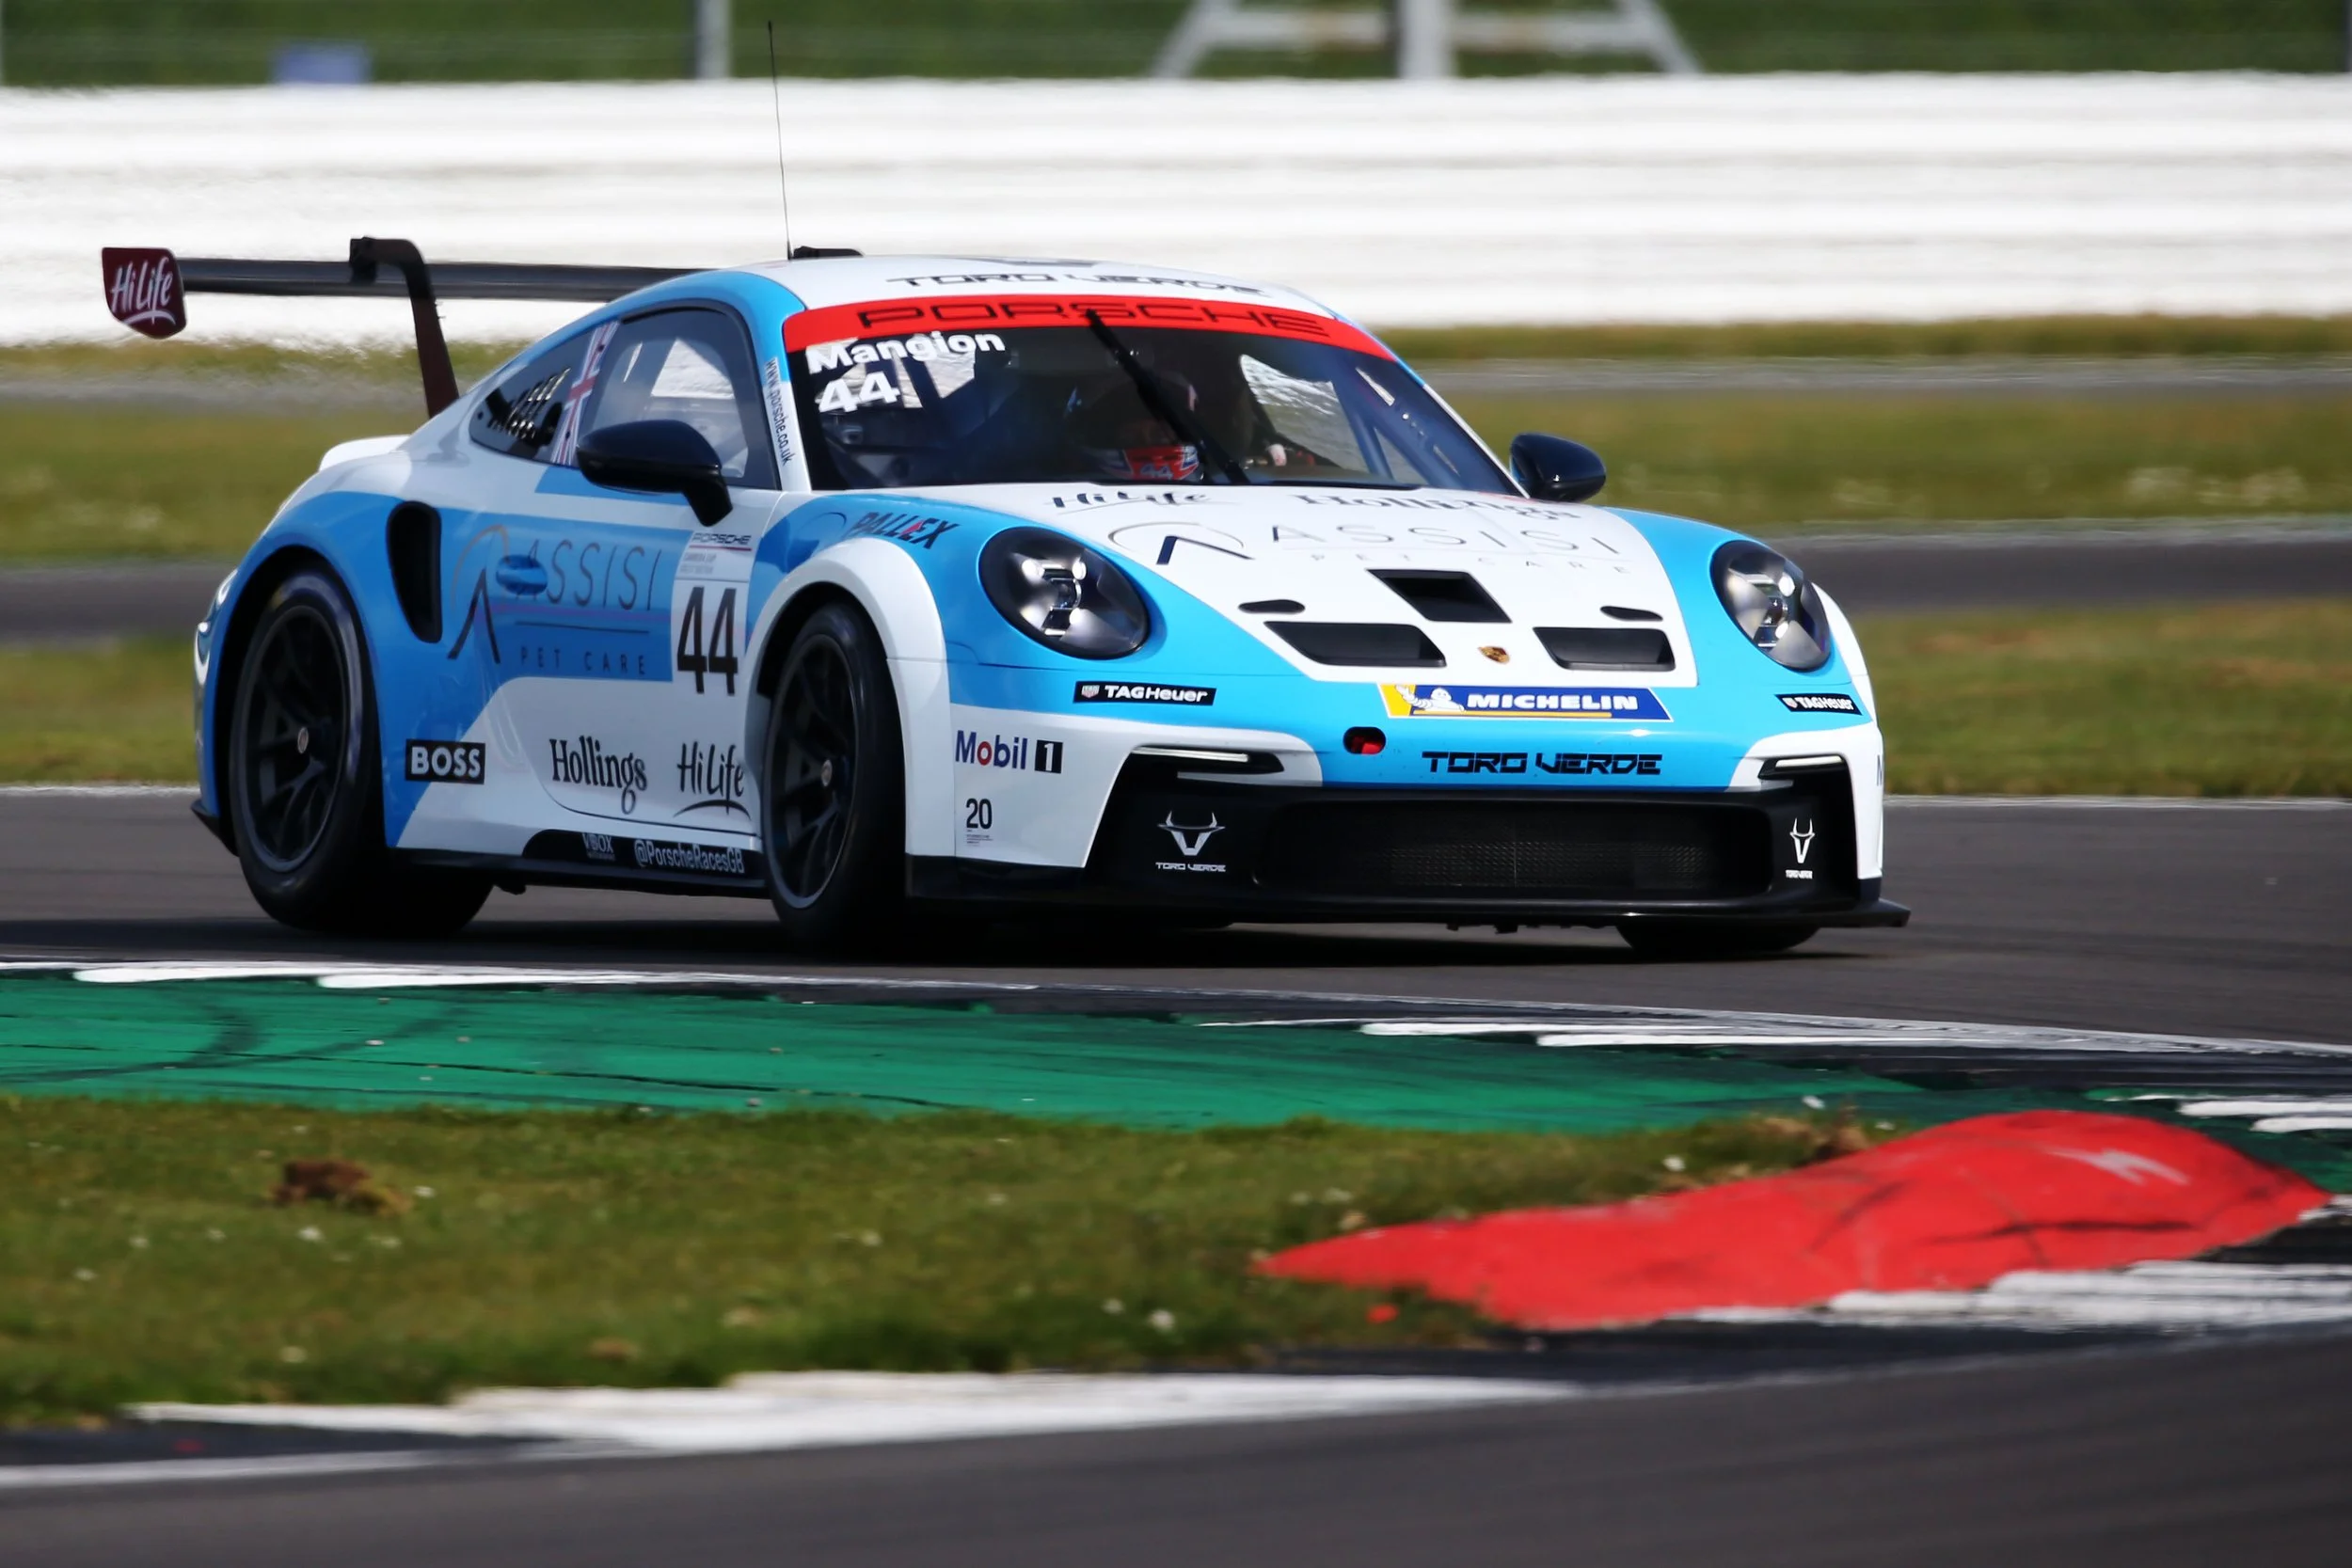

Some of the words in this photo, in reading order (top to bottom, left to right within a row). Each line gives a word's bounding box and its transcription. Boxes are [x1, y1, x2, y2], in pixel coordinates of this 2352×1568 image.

[110, 255, 174, 325] HiLife
[857, 300, 1330, 338] PORSCHE
[805, 330, 1006, 375] Mangion
[818, 371, 901, 413] 44
[766, 357, 796, 467] www.porsche.co.uk
[691, 531, 753, 546] PORSCHE
[1271, 523, 1621, 555] ASSISI
[676, 585, 739, 696] 44
[520, 646, 561, 669] PET
[583, 651, 646, 676] CARE
[1466, 691, 1640, 712] MICHELIN
[409, 746, 482, 779] BOSS
[955, 730, 1028, 770] Mobil
[1421, 751, 1528, 775] TORO
[1534, 752, 1663, 776] VERDE
[548, 735, 648, 816] Hollings
[676, 741, 746, 816] HiLife
[965, 798, 993, 830] 20
[633, 839, 746, 875] @PorscheRacesGB
[1154, 861, 1186, 871] TORO
